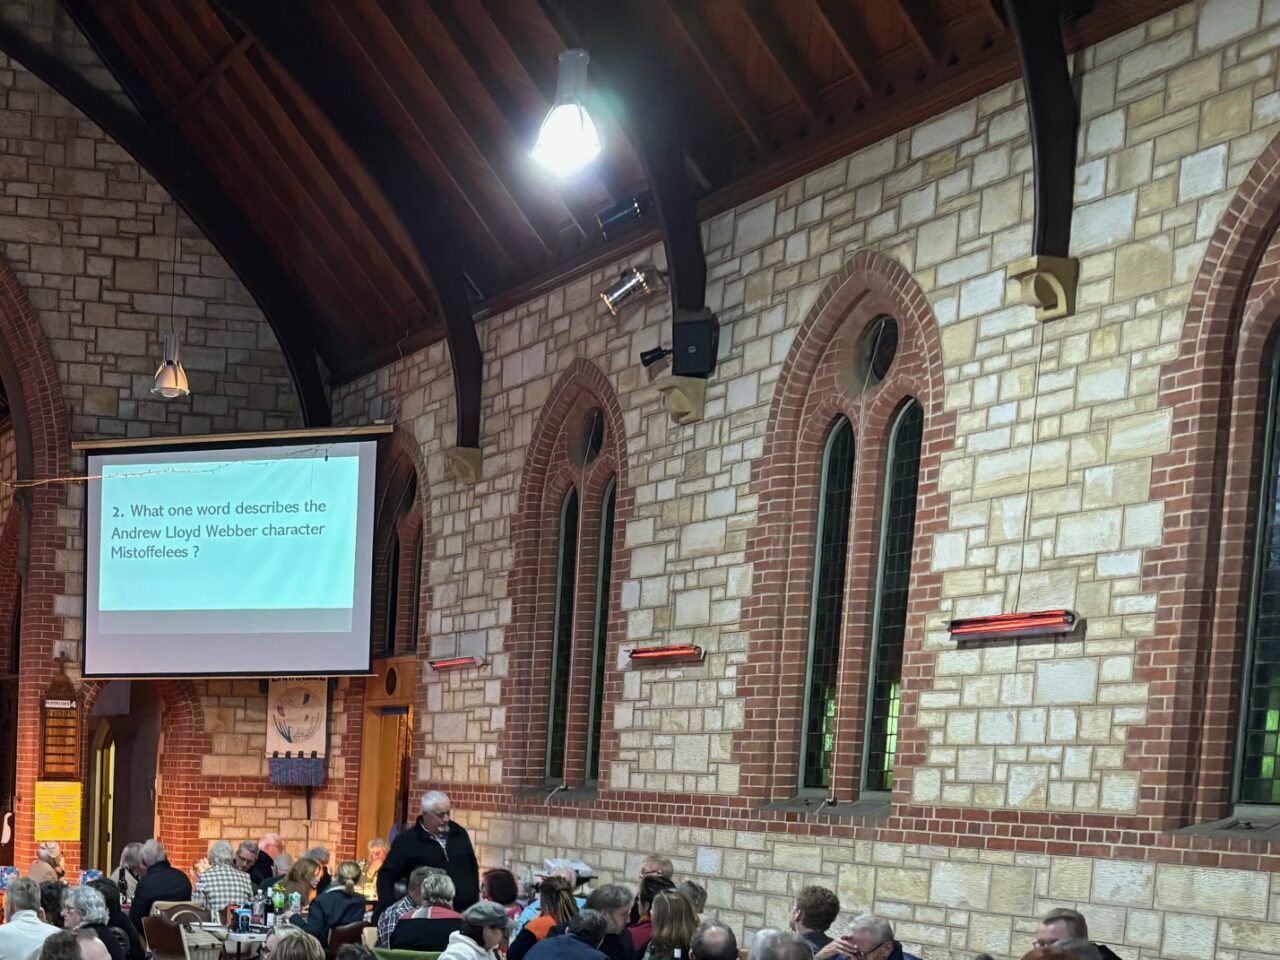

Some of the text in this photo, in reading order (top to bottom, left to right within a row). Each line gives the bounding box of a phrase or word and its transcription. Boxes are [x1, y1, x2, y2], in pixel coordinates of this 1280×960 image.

[112, 499, 326, 518] 2. What one word describes the
[111, 523, 325, 542] Andrew Lloyd Webber character
[111, 545, 200, 559] Mistoffelees ?
